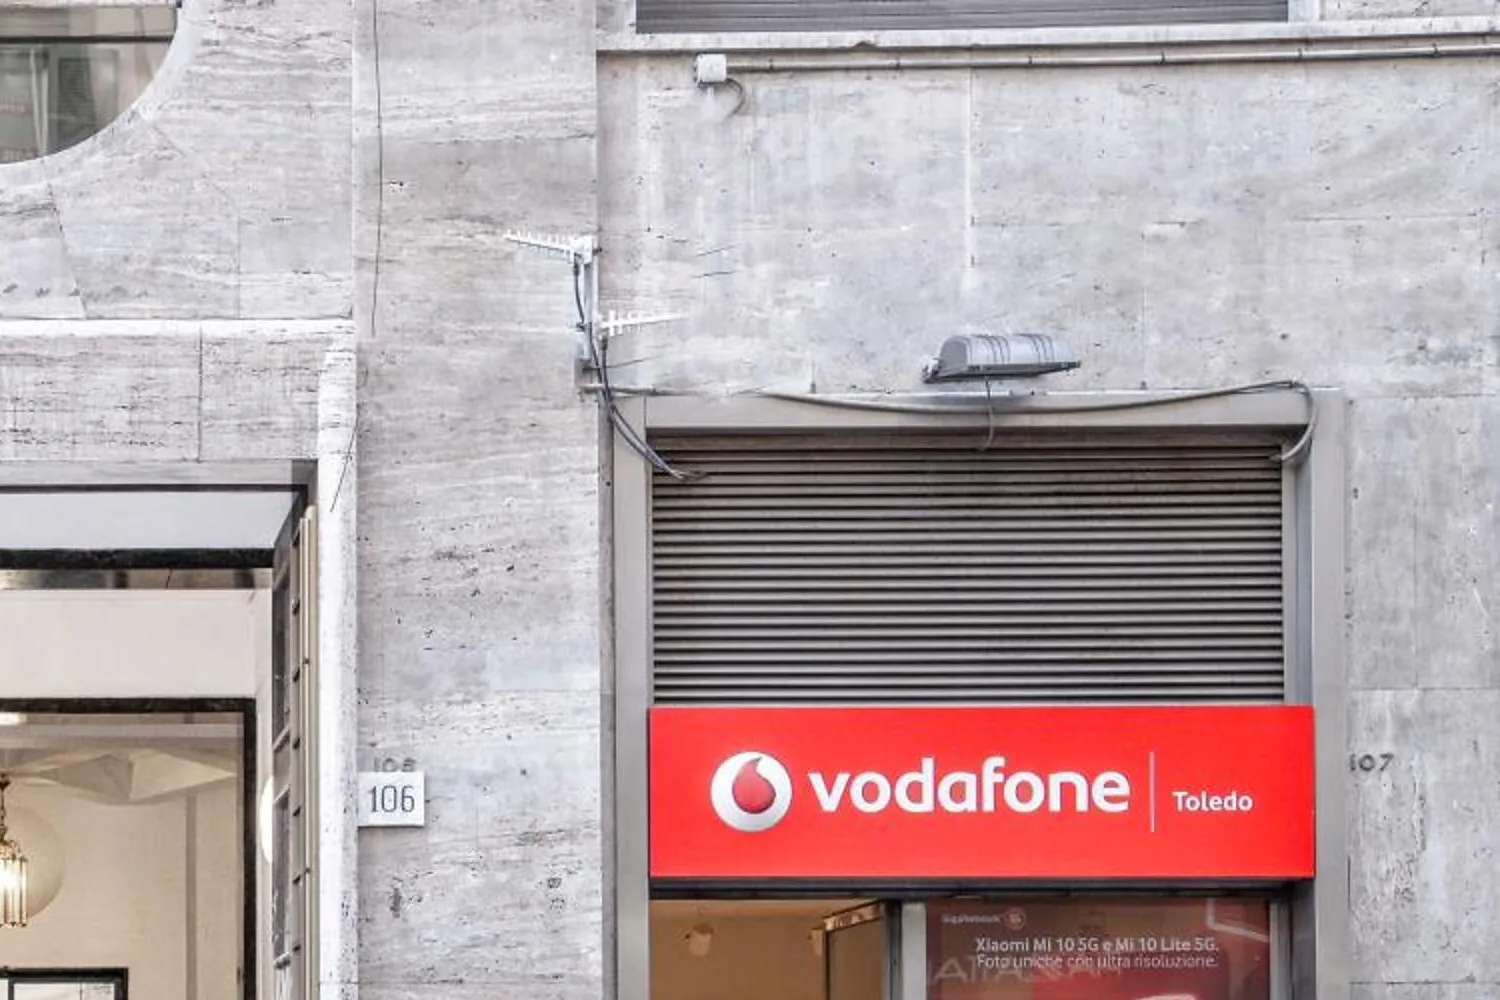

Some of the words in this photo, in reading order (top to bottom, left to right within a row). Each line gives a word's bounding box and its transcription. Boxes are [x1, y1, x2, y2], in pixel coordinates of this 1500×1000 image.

[1349, 752, 1395, 772] 107
[809, 757, 1129, 814] vodafone
[1173, 790, 1253, 812] Toledo
[368, 785, 415, 813] 106
[975, 937, 1029, 952] Xiaomi
[1033, 937, 1051, 952] Mi
[1057, 937, 1074, 952] 10
[1078, 937, 1099, 952] 5G
[1102, 941, 1111, 951] e
[1115, 937, 1134, 951] Mi
[1140, 937, 1157, 951] 10
[1161, 937, 1191, 951] Lite
[1195, 937, 1219, 952] 5G.
[977, 954, 1010, 968] Foto
[1013, 954, 1063, 968] uniche
[1067, 957, 1093, 968] con
[1098, 953, 1131, 968] ultra
